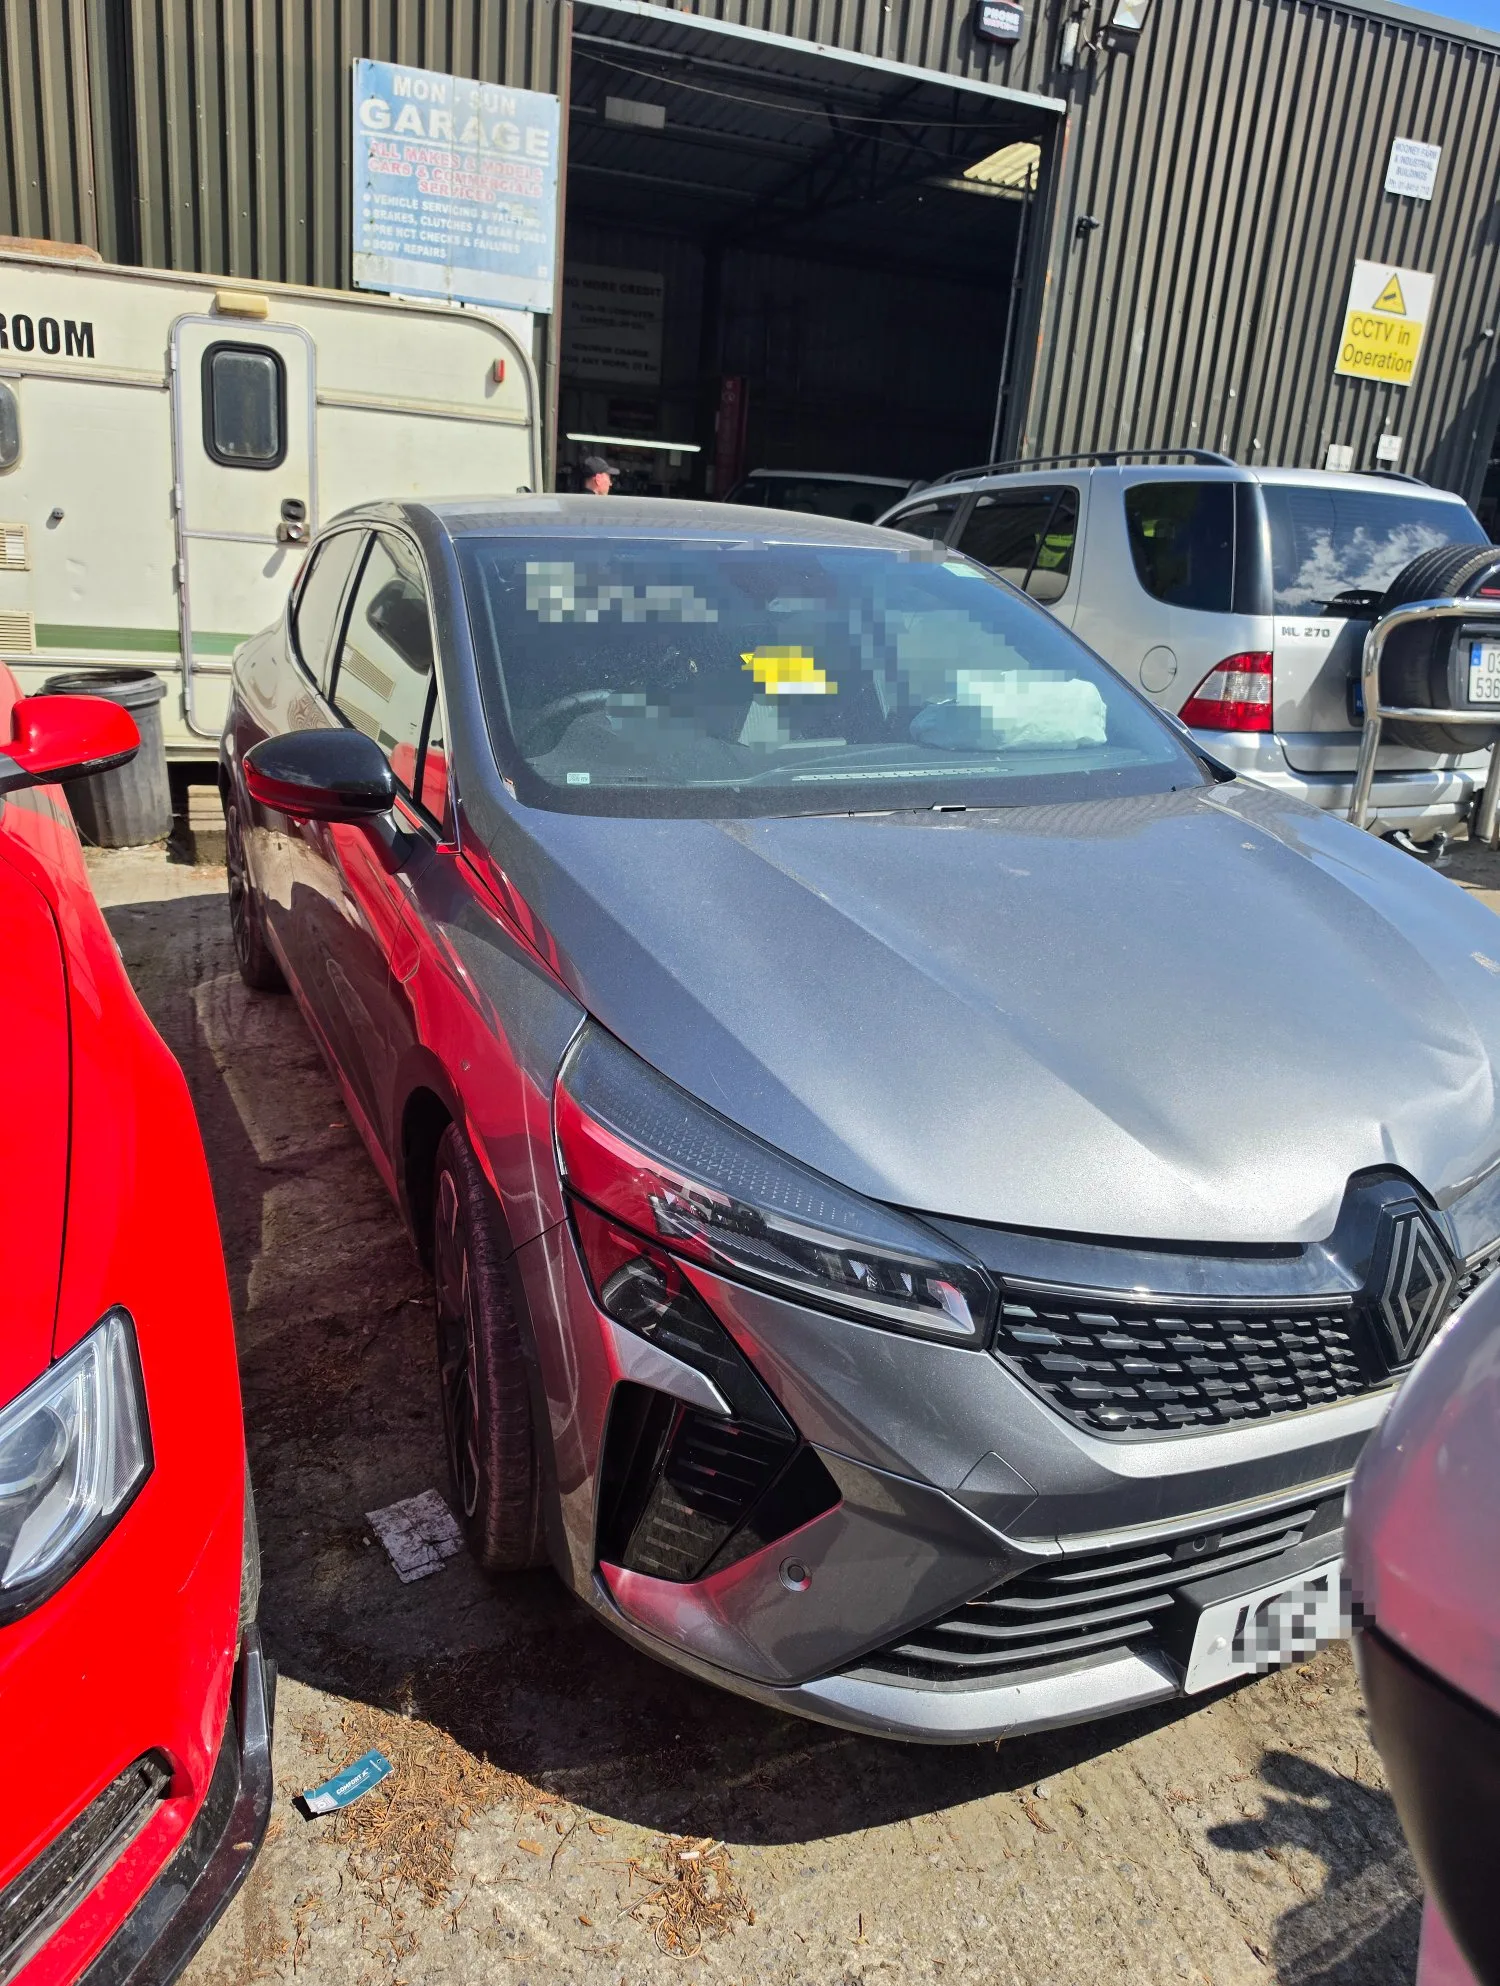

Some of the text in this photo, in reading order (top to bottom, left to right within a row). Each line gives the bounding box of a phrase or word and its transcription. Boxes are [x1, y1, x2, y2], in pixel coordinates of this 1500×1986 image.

[393, 75, 446, 103] MON
[468, 90, 517, 117] SUN
[359, 98, 550, 158] GARAGE
[370, 142, 543, 182] ALL MAKES & MODELS
[369, 158, 542, 199] CARS & COMMERCIALS
[418, 180, 497, 203] SERVICED
[373, 194, 418, 210] VEHICLE
[422, 201, 478, 218] SERVICING
[373, 223, 395, 237] PRE
[395, 226, 418, 239] NCT
[419, 230, 461, 247] CHECKS
[420, 216, 473, 232] CLUTCHES
[372, 239, 447, 259] BODY REPAIRS
[583, 280, 617, 293] MORE
[619, 283, 662, 298] CREDIT
[1351, 317, 1411, 347] CCTV in
[1343, 343, 1413, 374] Operation
[1281, 626, 1331, 638] ML 270
[336, 1772, 362, 1796] COMFORT
